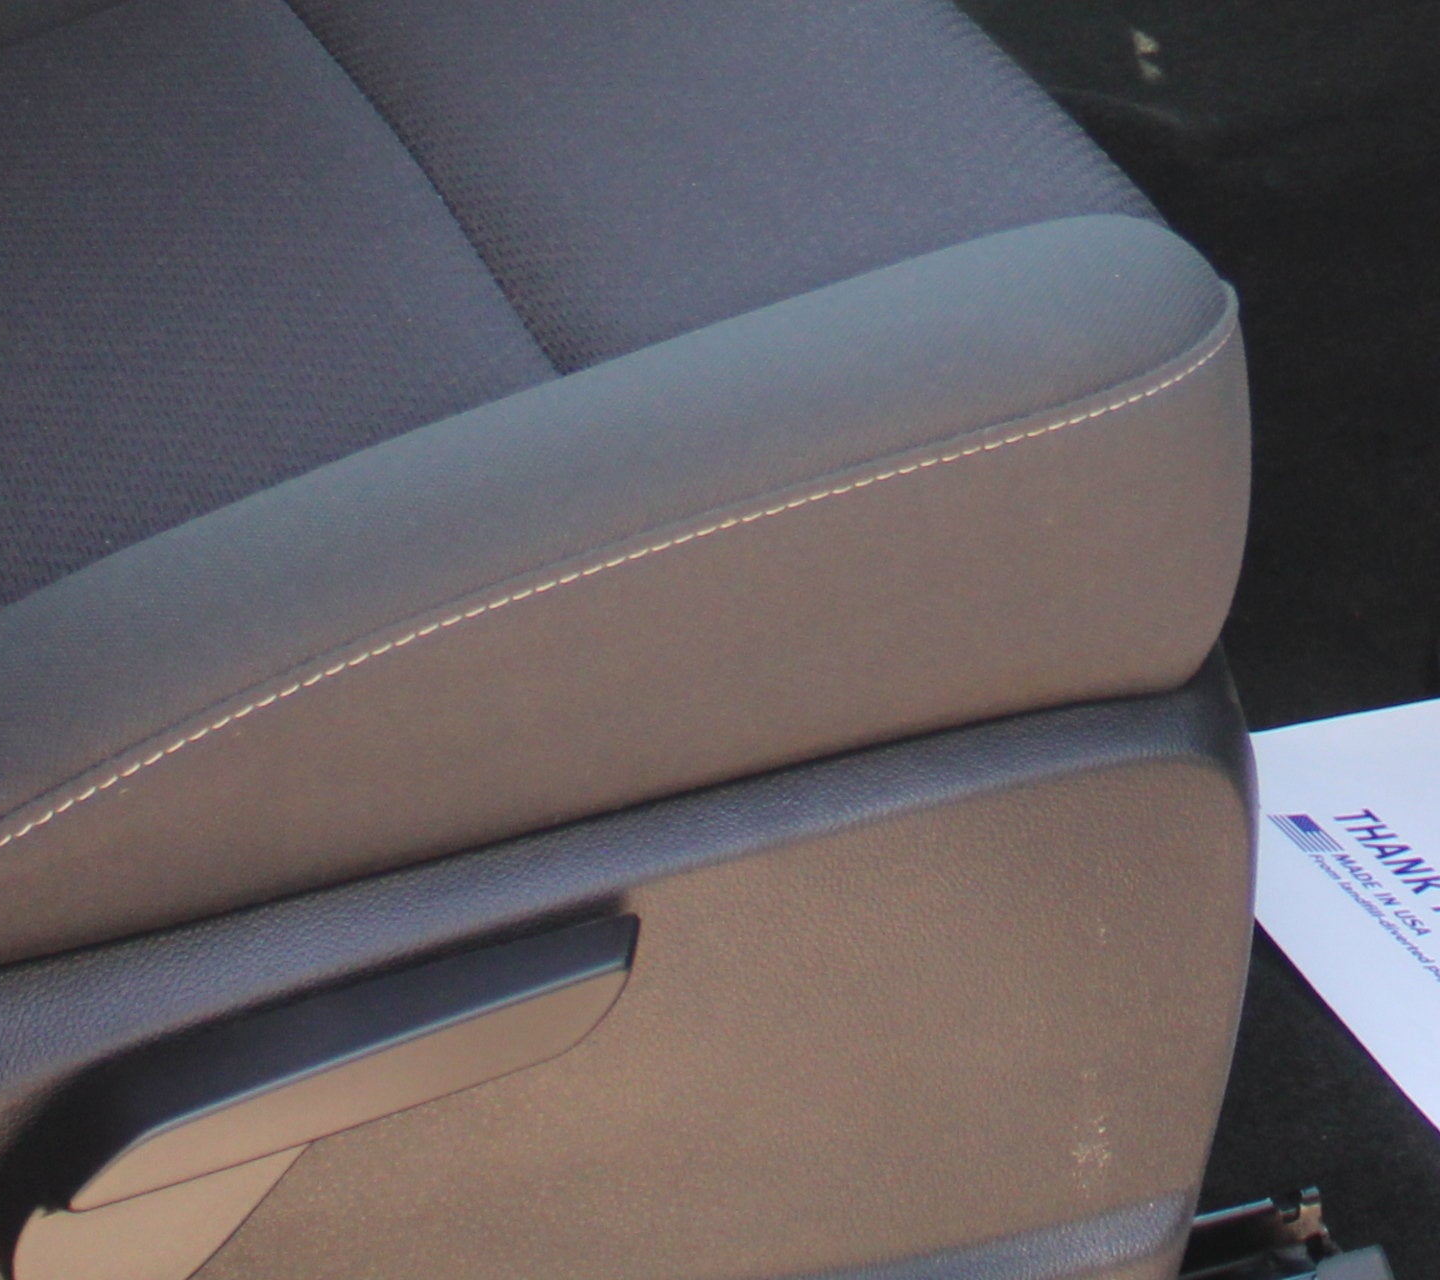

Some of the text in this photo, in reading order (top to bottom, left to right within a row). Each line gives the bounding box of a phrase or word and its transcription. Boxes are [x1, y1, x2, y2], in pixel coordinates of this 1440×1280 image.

[1308, 853, 1342, 880] From
[1331, 853, 1432, 936] MADE IN USA
